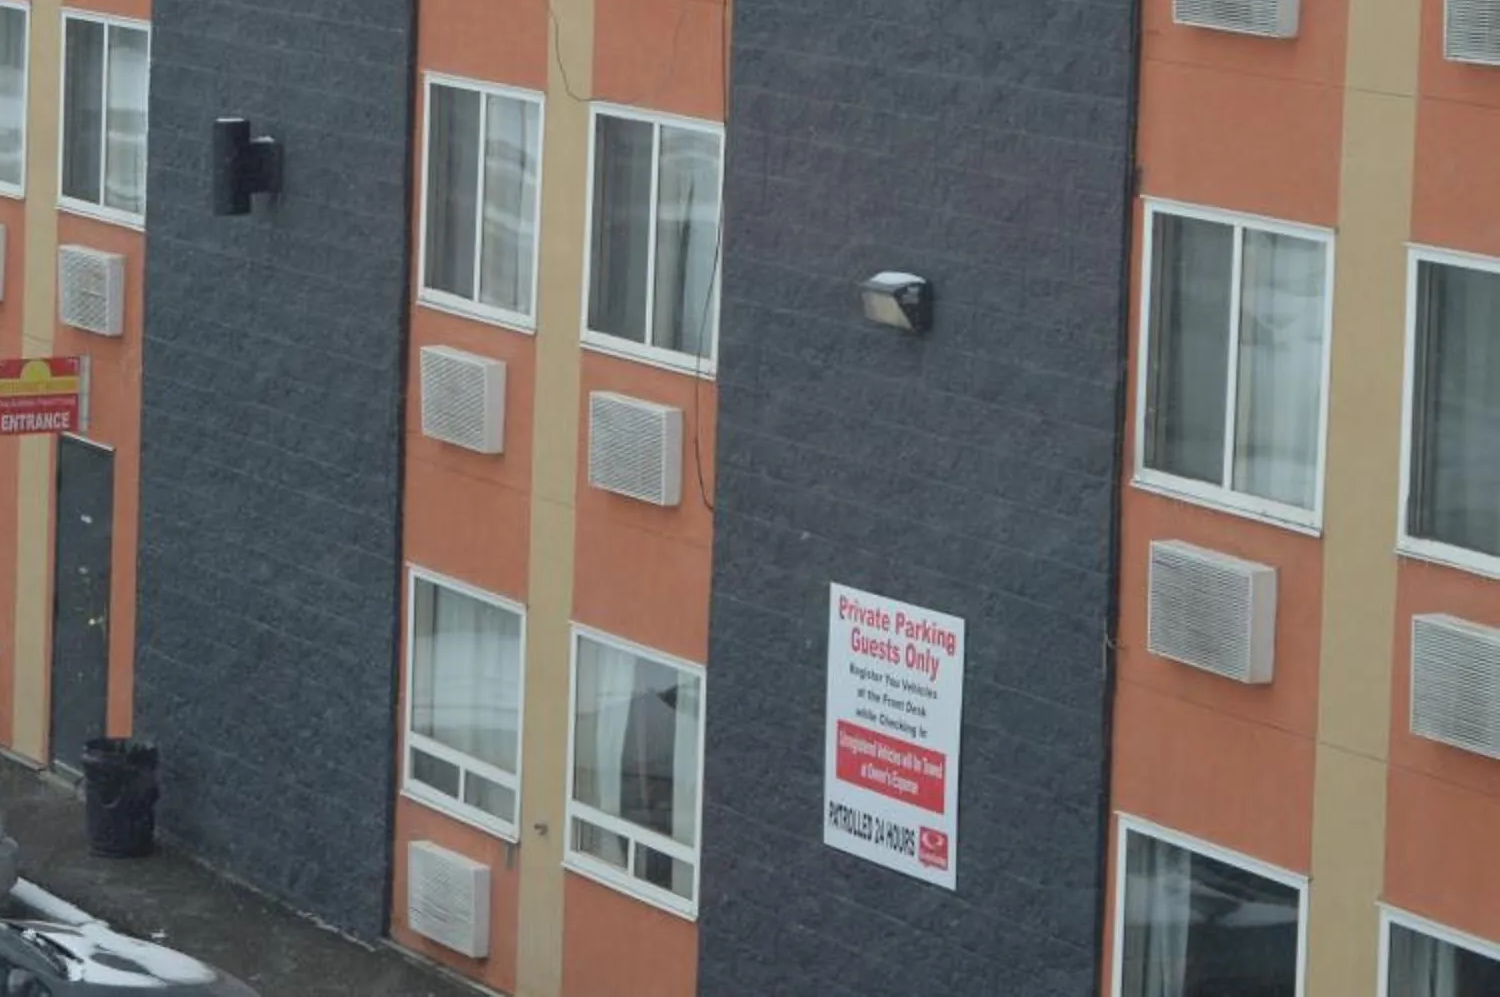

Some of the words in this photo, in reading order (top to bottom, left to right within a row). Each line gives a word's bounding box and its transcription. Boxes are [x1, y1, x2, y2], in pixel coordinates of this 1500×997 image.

[1, 411, 70, 431] ENTRANCE
[838, 594, 891, 632] Private
[895, 611, 957, 657] Parking
[851, 627, 901, 666] Guests
[905, 643, 940, 682] Only
[906, 701, 926, 716] Desk
[828, 800, 872, 842] PATROLLED
[874, 815, 885, 844] 24
[885, 818, 915, 857] HOURS
